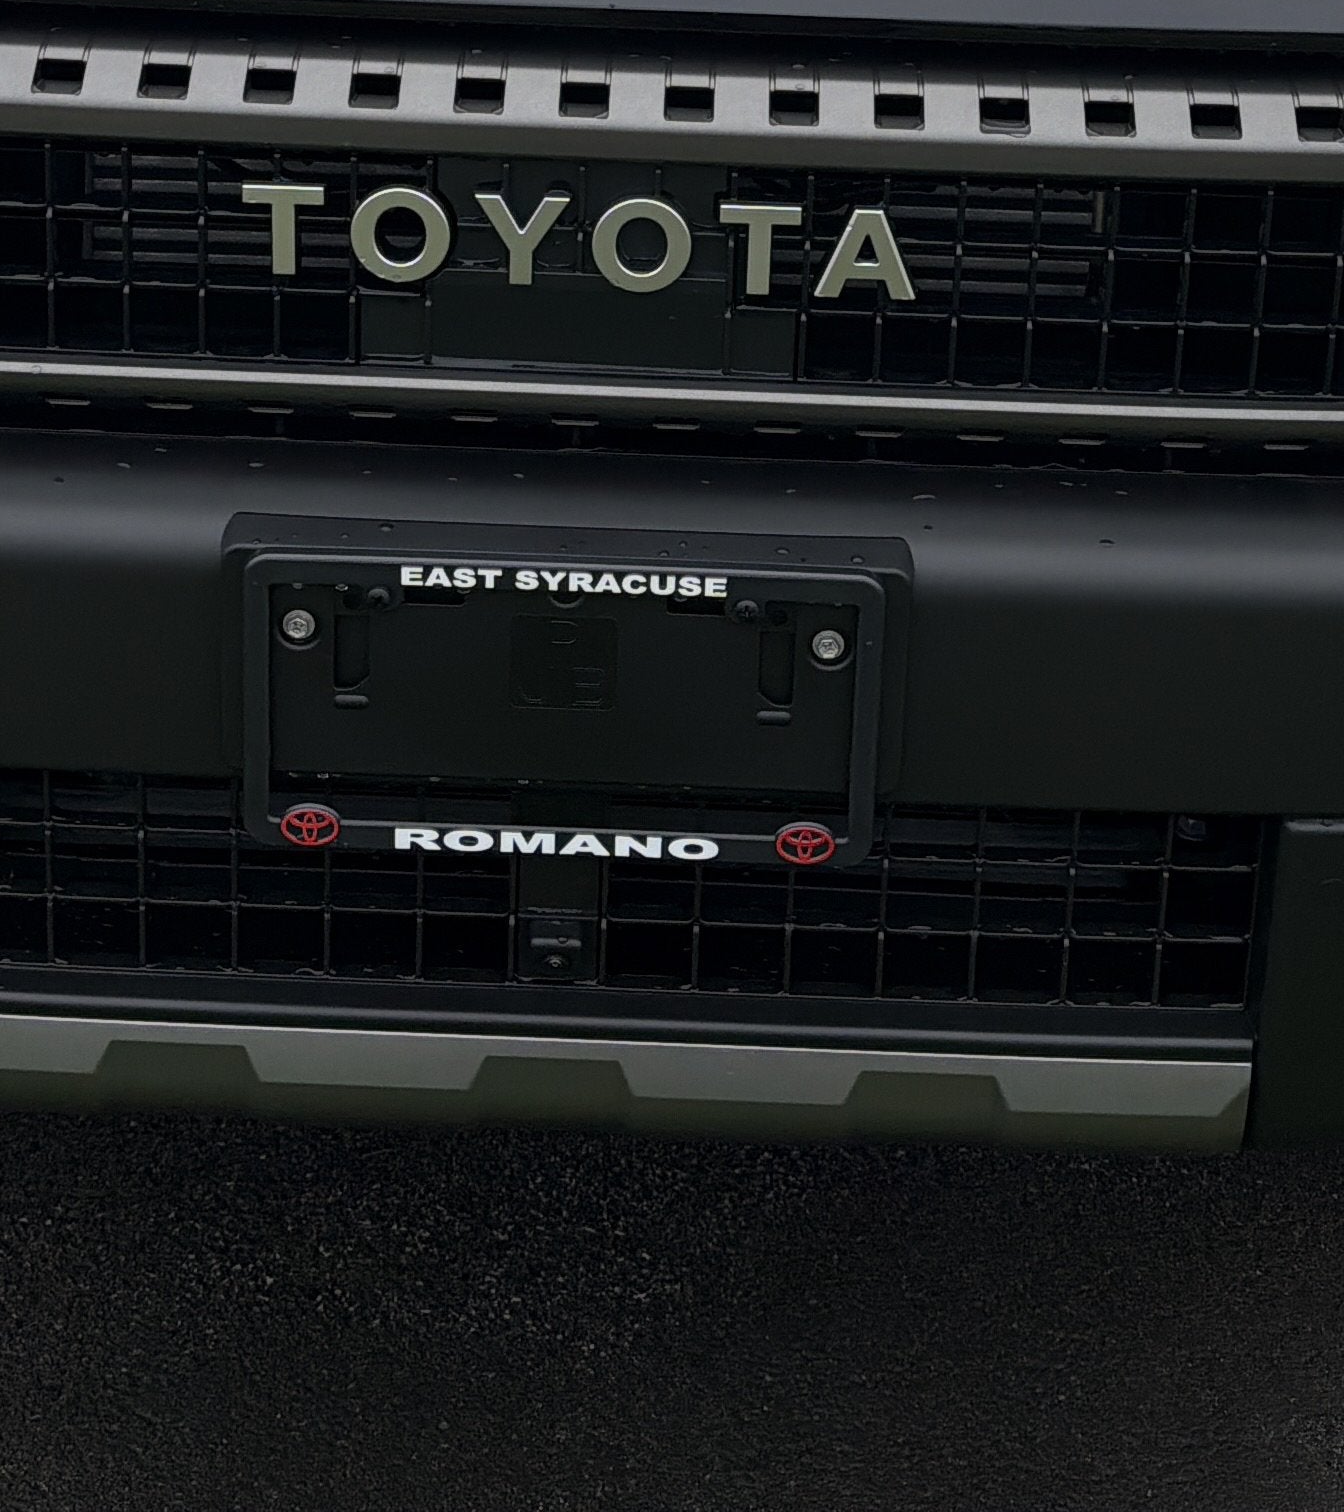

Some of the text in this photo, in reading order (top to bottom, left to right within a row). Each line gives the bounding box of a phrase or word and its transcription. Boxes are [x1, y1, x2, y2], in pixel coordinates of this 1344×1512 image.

[242, 183, 917, 302] TOYOTA
[400, 566, 728, 598] EAST SYRACUSE
[394, 828, 719, 860] ROMANO
